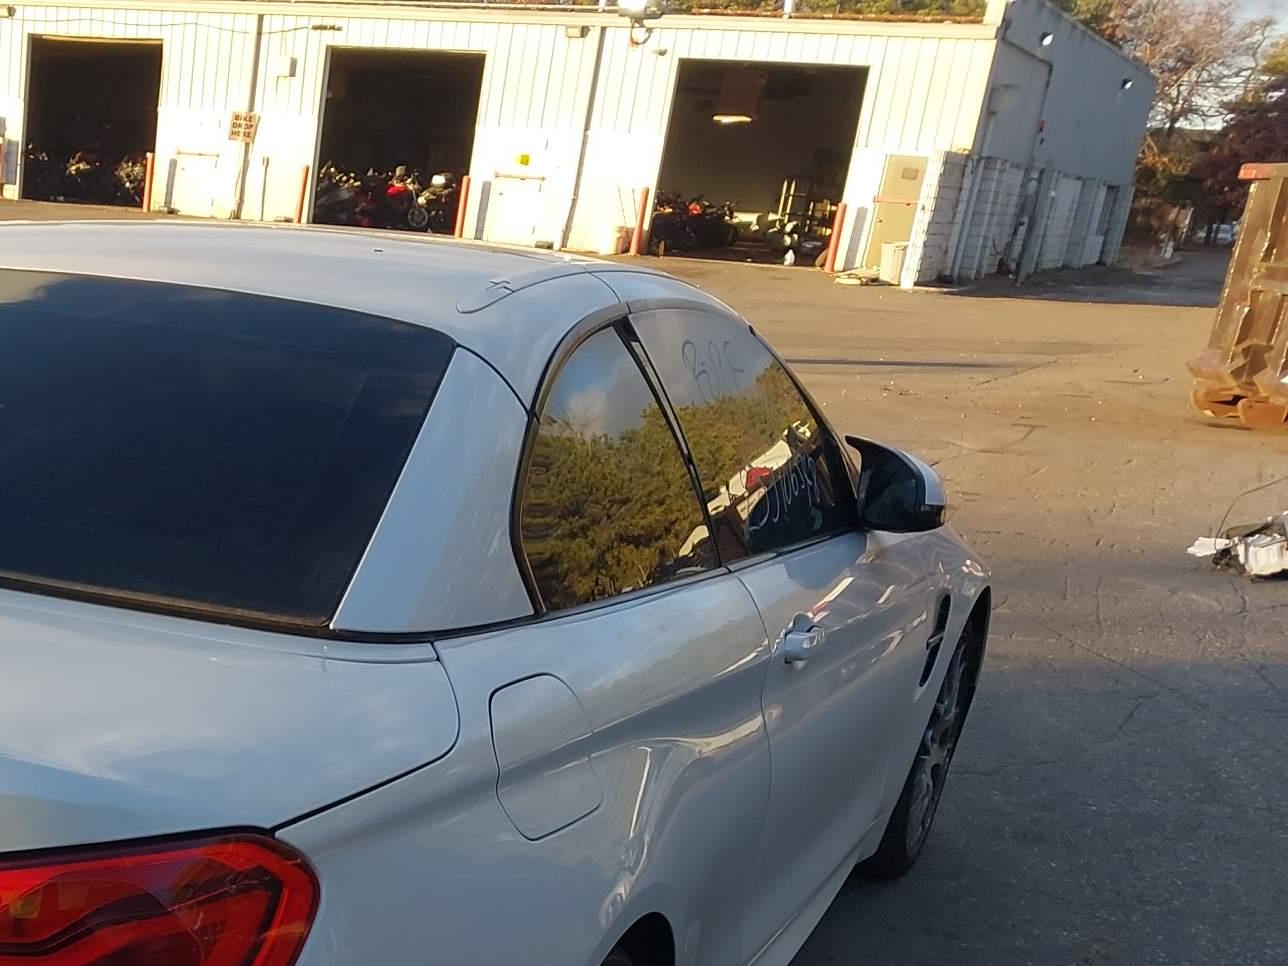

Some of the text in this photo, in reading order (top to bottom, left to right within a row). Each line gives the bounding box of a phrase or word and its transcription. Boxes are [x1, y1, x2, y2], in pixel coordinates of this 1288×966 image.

[234, 114, 255, 122] BIKE
[232, 122, 254, 130] DROP
[231, 130, 252, 138] HERE
